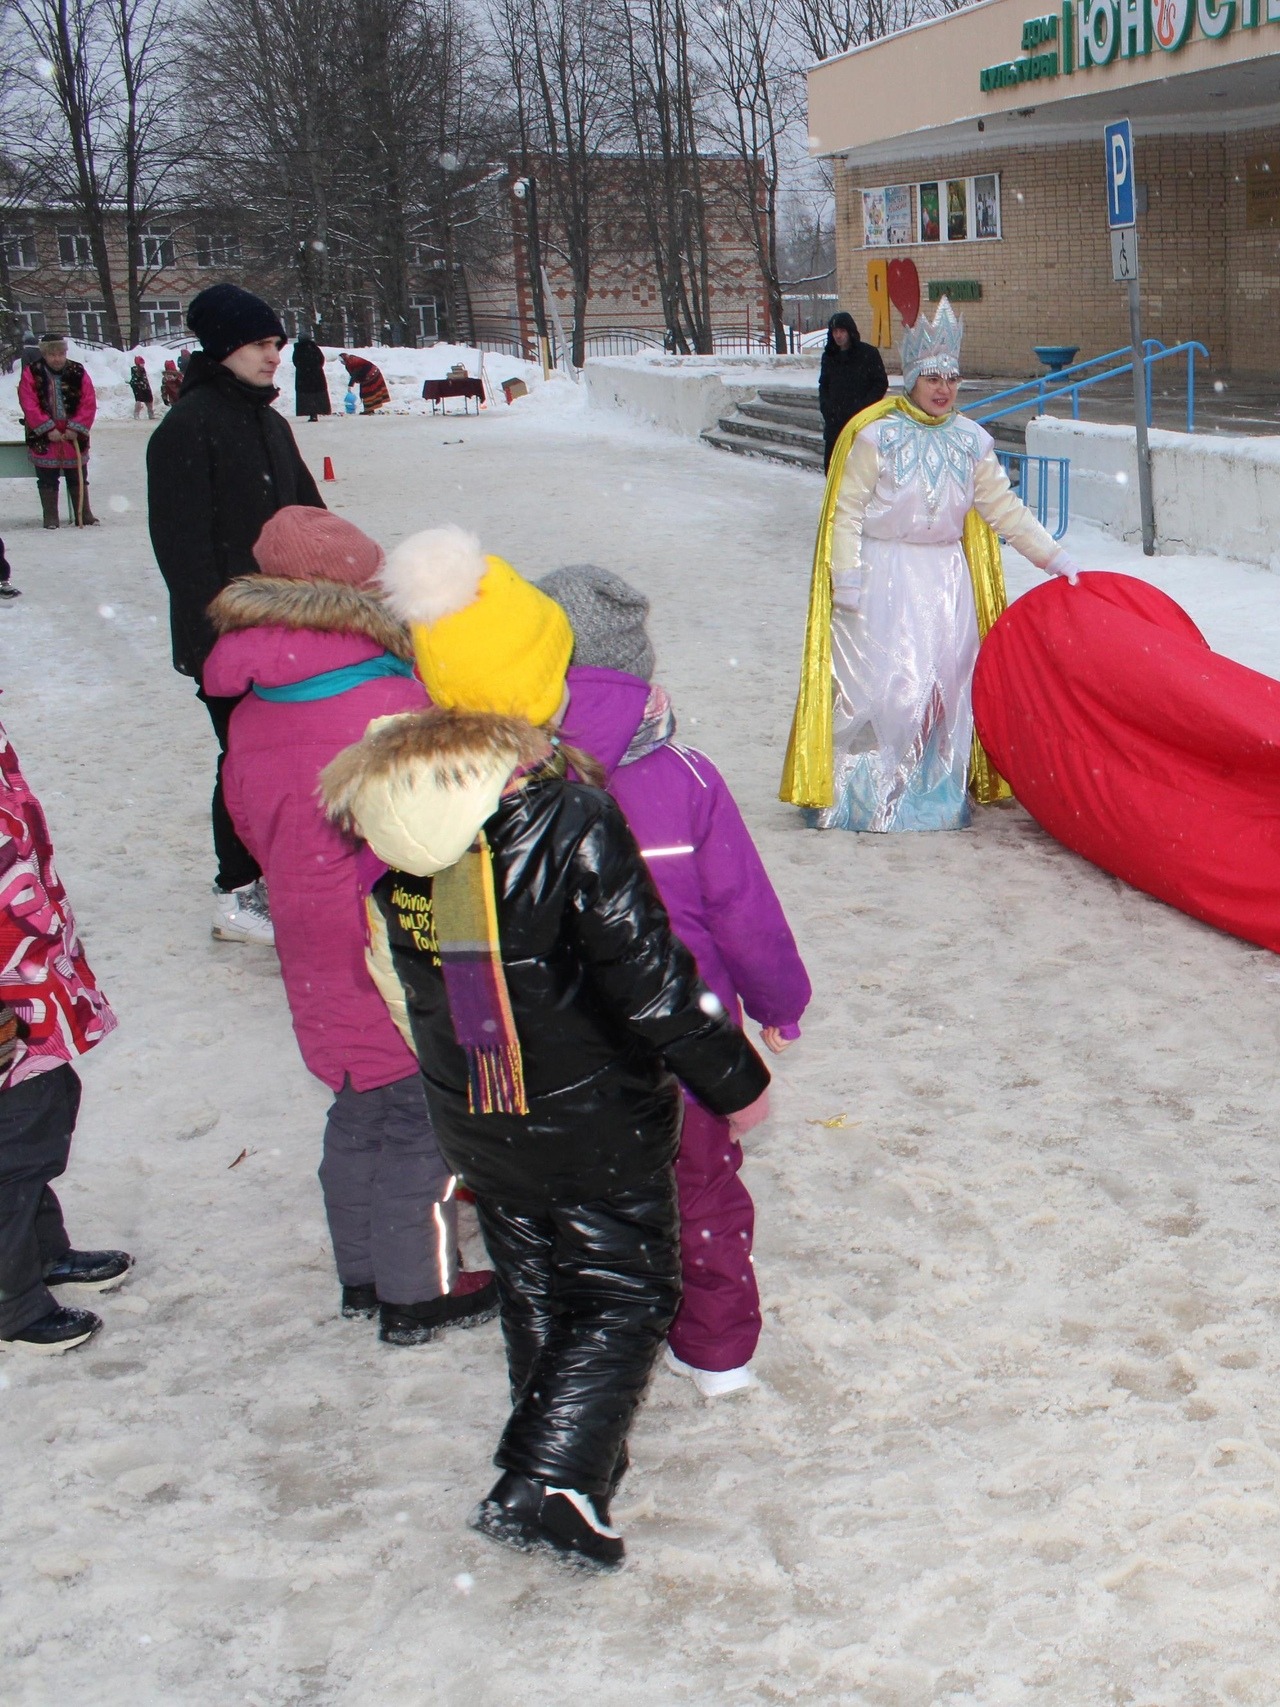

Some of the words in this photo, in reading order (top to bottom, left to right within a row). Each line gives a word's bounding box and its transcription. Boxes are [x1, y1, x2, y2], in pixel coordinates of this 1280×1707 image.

[1021, 15, 1058, 50] ДОМ
[980, 52, 1058, 92] КУЛЬТУРЫ
[1111, 133, 1127, 215] P
